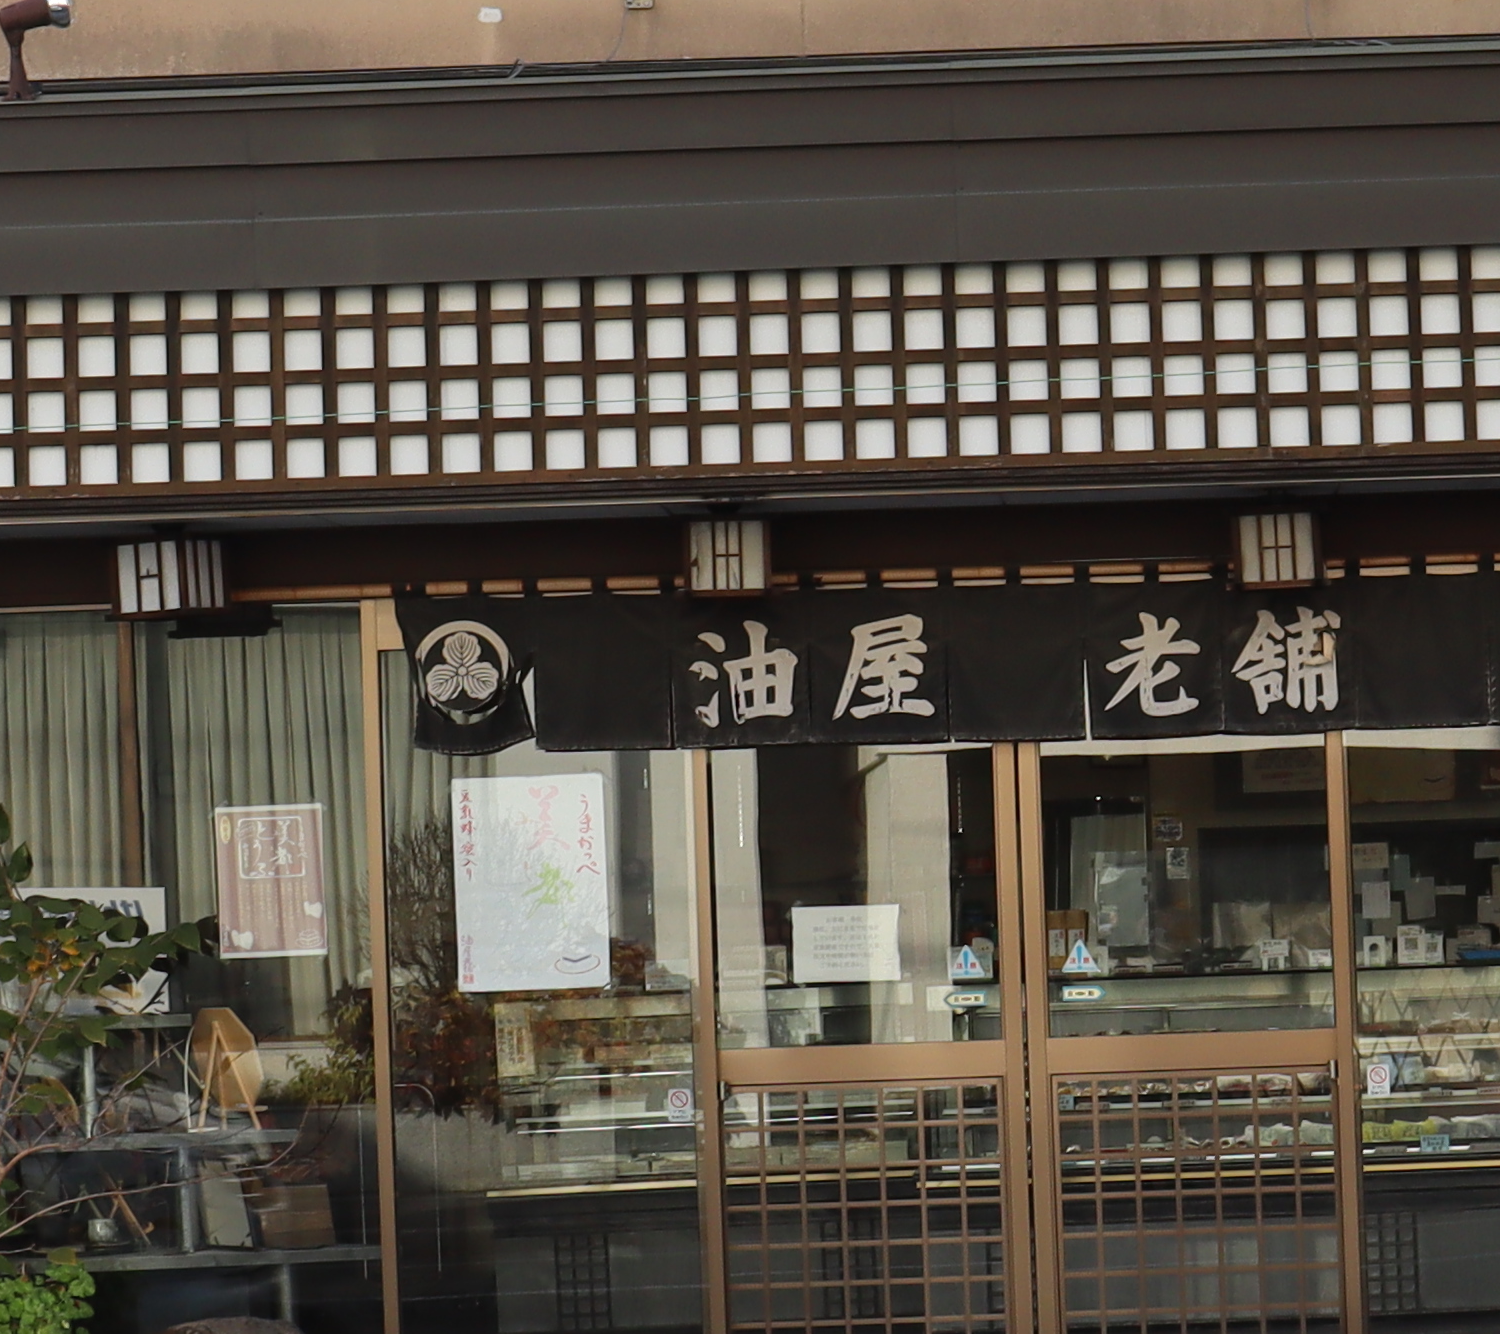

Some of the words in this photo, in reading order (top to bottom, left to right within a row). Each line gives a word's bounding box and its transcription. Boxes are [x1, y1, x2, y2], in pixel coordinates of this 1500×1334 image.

[689, 613, 936, 728] 油屋
[1104, 606, 1341, 717] 老舗
[577, 793, 601, 875] うまかっぺ
